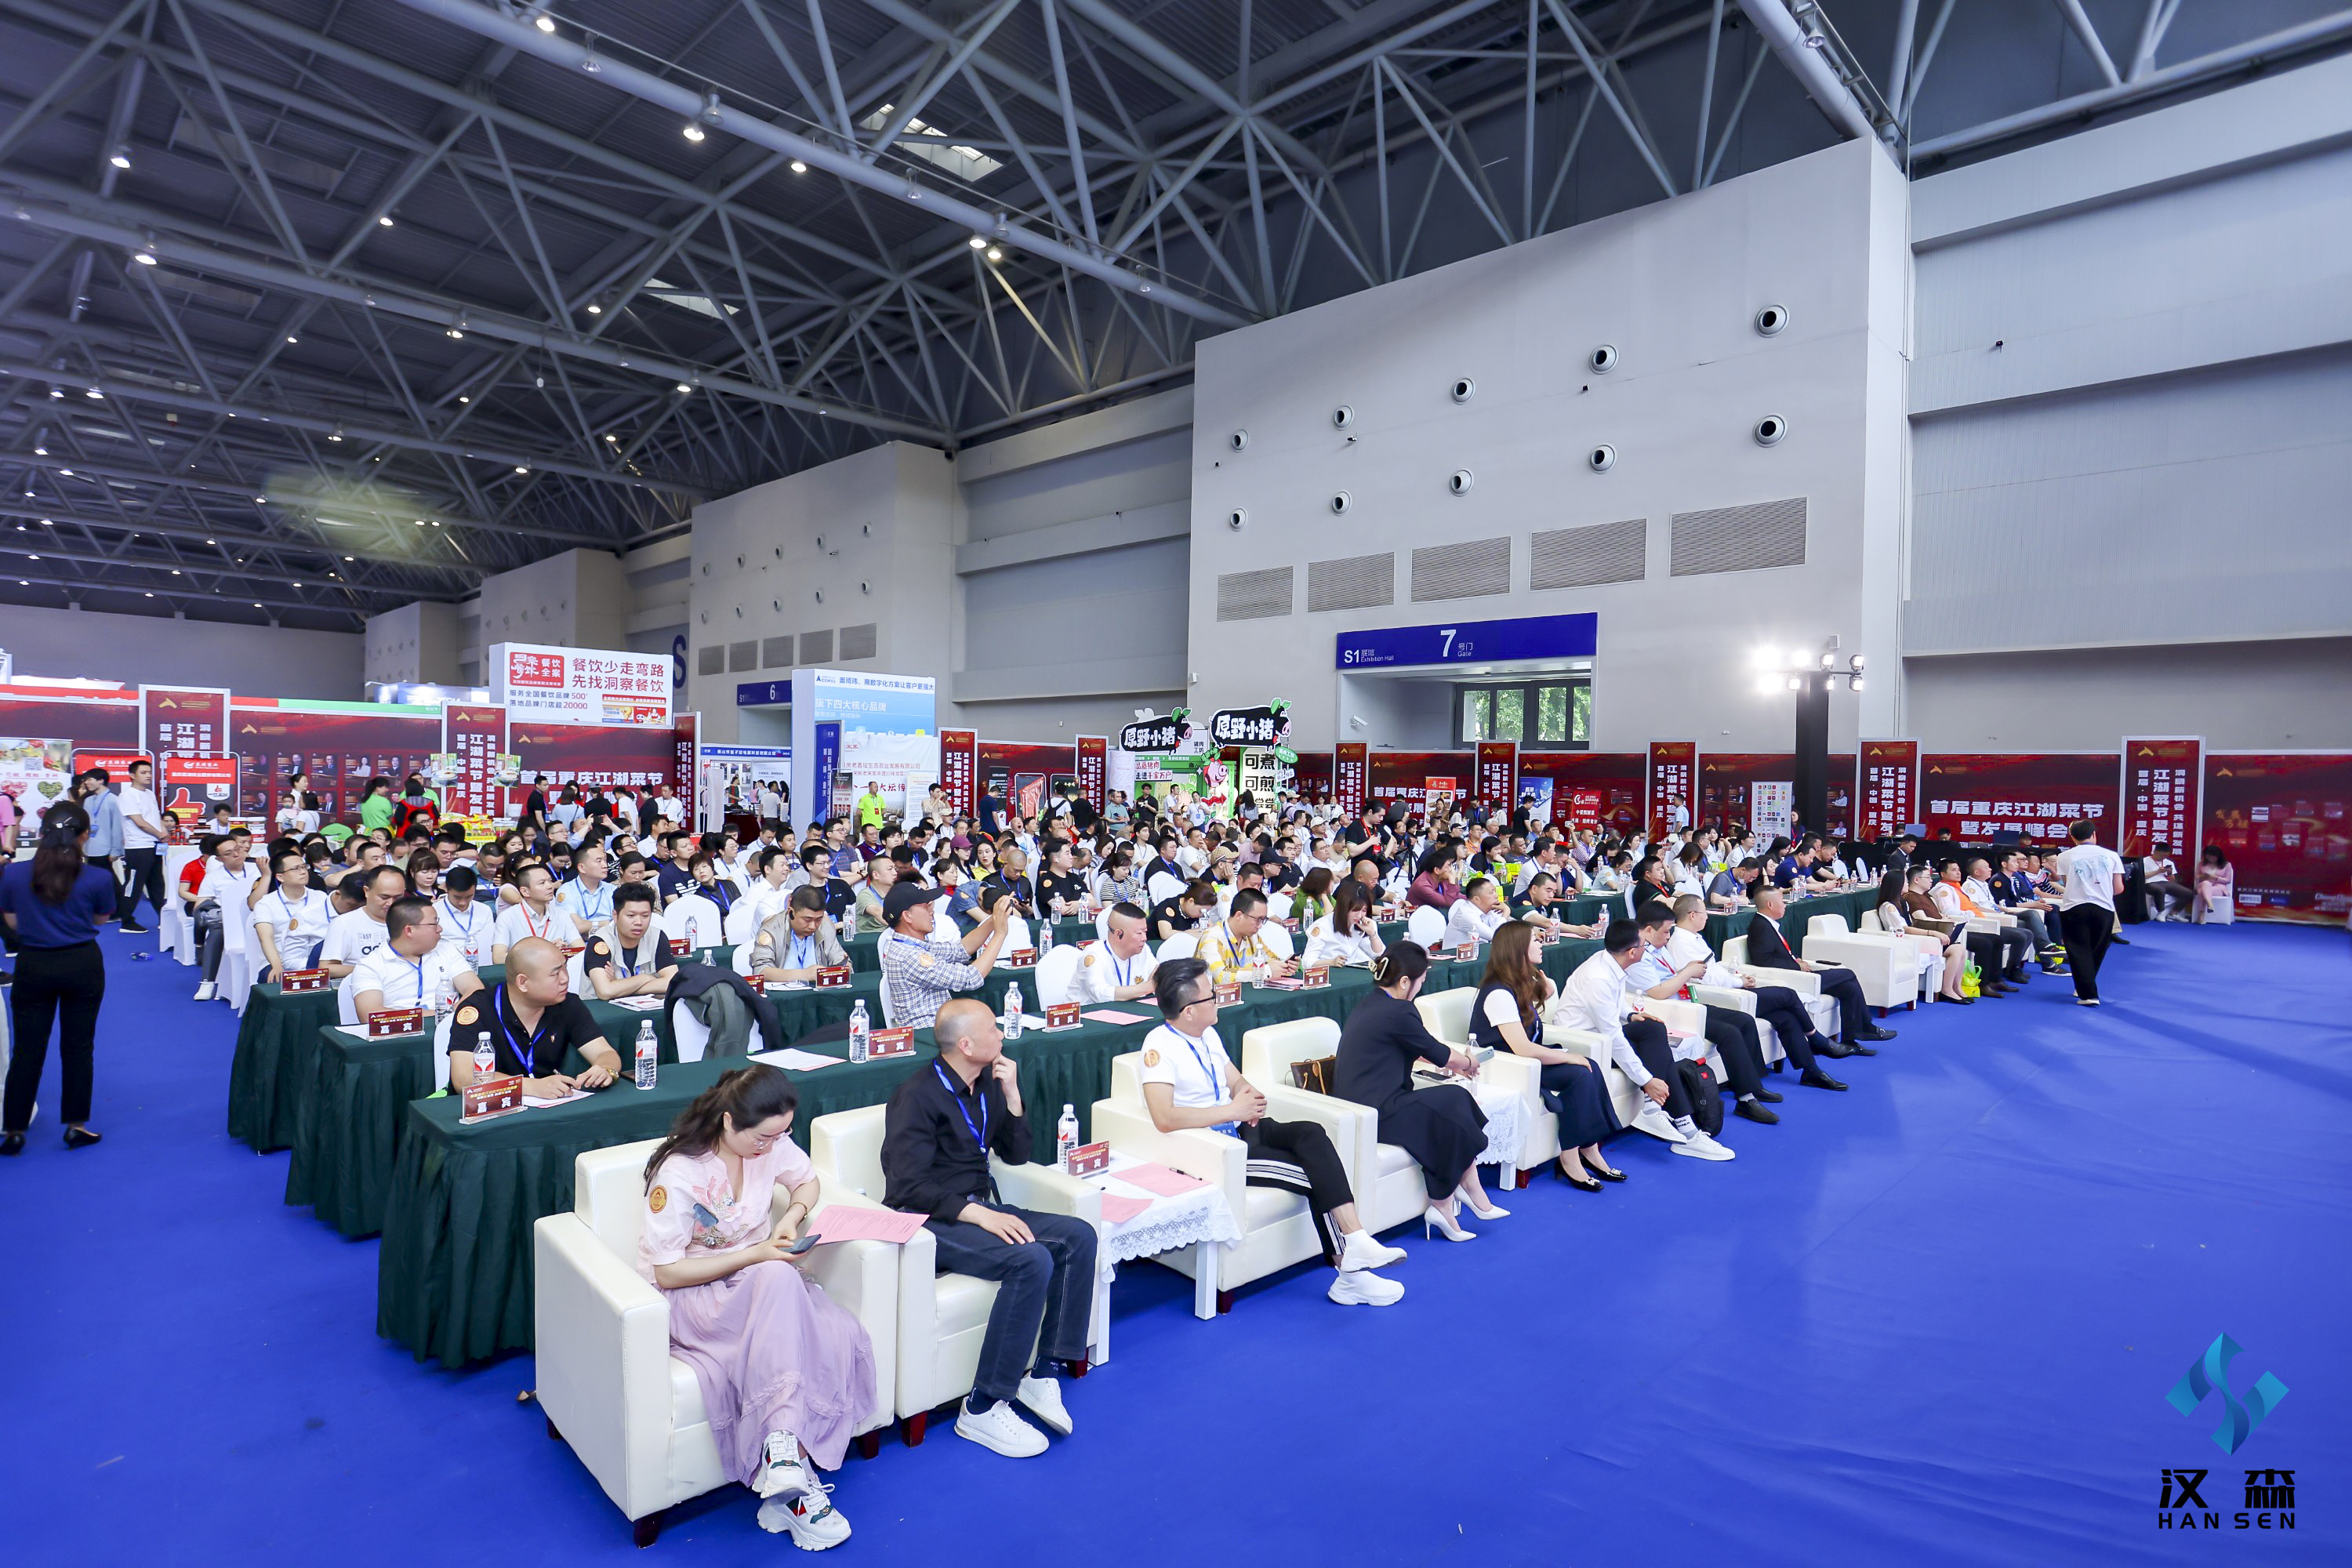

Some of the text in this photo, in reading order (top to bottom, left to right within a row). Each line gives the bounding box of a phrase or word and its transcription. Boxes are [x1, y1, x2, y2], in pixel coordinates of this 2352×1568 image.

[1441, 630, 1456, 657] 7
[541, 658, 561, 668] 餐饮
[673, 634, 687, 688] S
[1345, 650, 1359, 662] S1
[541, 668, 561, 678] 全案
[572, 658, 664, 677] 餐饮少走弯路
[572, 674, 664, 693] 先找洞察餐饮
[770, 684, 775, 700] 6
[1215, 714, 1274, 740] 原野小猪
[1124, 725, 1175, 748] 原野小猪
[1135, 761, 1160, 770] 品质猪肉
[1245, 753, 1276, 770] 可煮
[520, 770, 663, 786] 首届重庆江湖菜节
[1135, 771, 1171, 780] 走进千家万户
[1245, 775, 1275, 792] 可煎
[1880, 767, 1895, 835] 江湖菜节暨发
[1930, 800, 2104, 818] 首届重庆江湖菜节
[2151, 769, 2170, 854] 江湖菜节暨发
